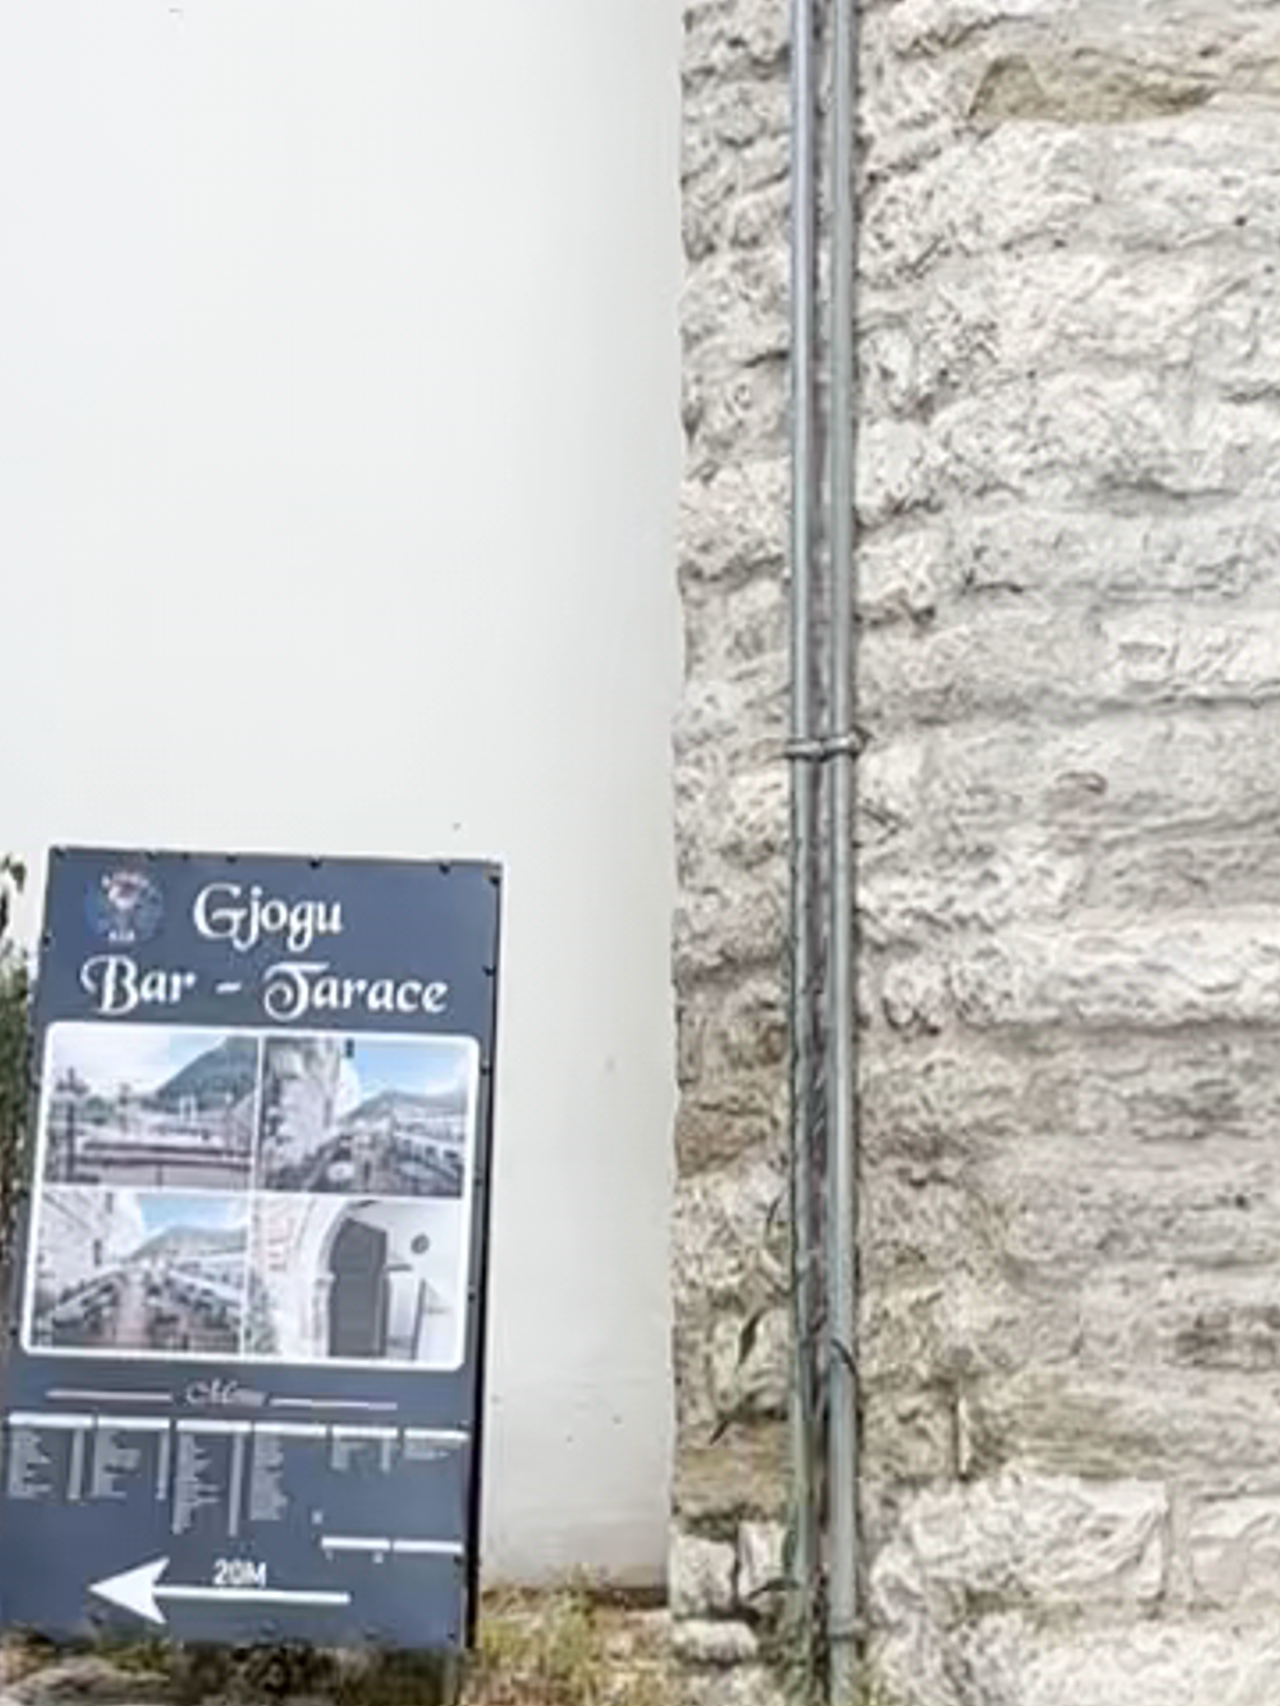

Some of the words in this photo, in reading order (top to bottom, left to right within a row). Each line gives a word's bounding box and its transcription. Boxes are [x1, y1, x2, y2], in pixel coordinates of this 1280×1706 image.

[192, 882, 344, 952] Gjogu
[79, 954, 196, 1016] Bar
[263, 961, 448, 1022] Tarace
[213, 1558, 267, 1587] 20M
